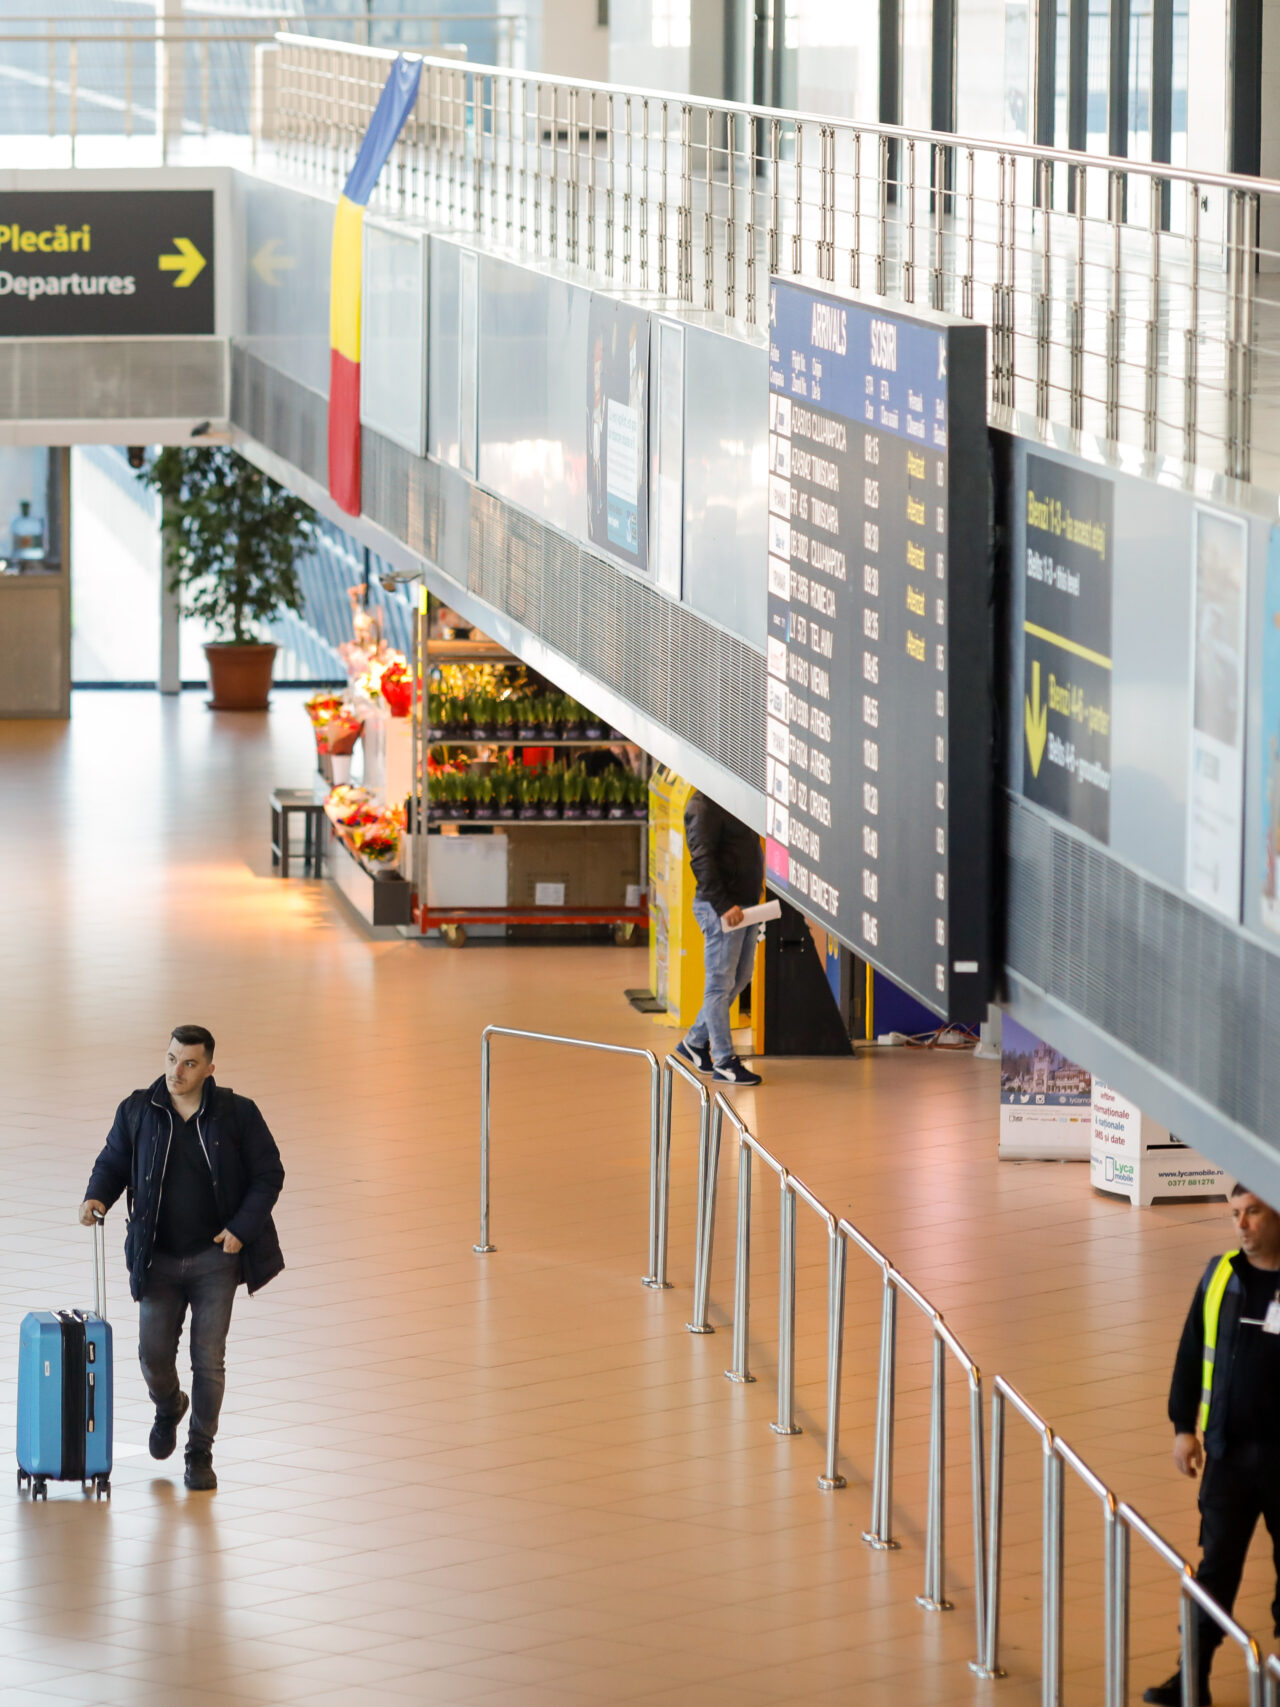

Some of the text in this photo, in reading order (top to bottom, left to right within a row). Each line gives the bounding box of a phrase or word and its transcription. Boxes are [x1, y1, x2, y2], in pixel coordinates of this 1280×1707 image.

[811, 300, 896, 372] ARRIVALS SOSIRI
[880, 380, 889, 401] ETA
[1027, 488, 1048, 531] Benzi
[1048, 497, 1061, 537] 1-3
[1026, 546, 1043, 582] Belts
[1043, 554, 1052, 586] 1-3
[809, 622, 820, 652] TEL
[1047, 670, 1070, 718] Benzi
[810, 705, 831, 743] ATHENS
[810, 747, 830, 786] ATHENS
[1047, 730, 1064, 768] Belts
[1110, 1134, 1126, 1146] date
[1114, 1160, 1134, 1174] Lyca
[1114, 1173, 1134, 1183] mobile
